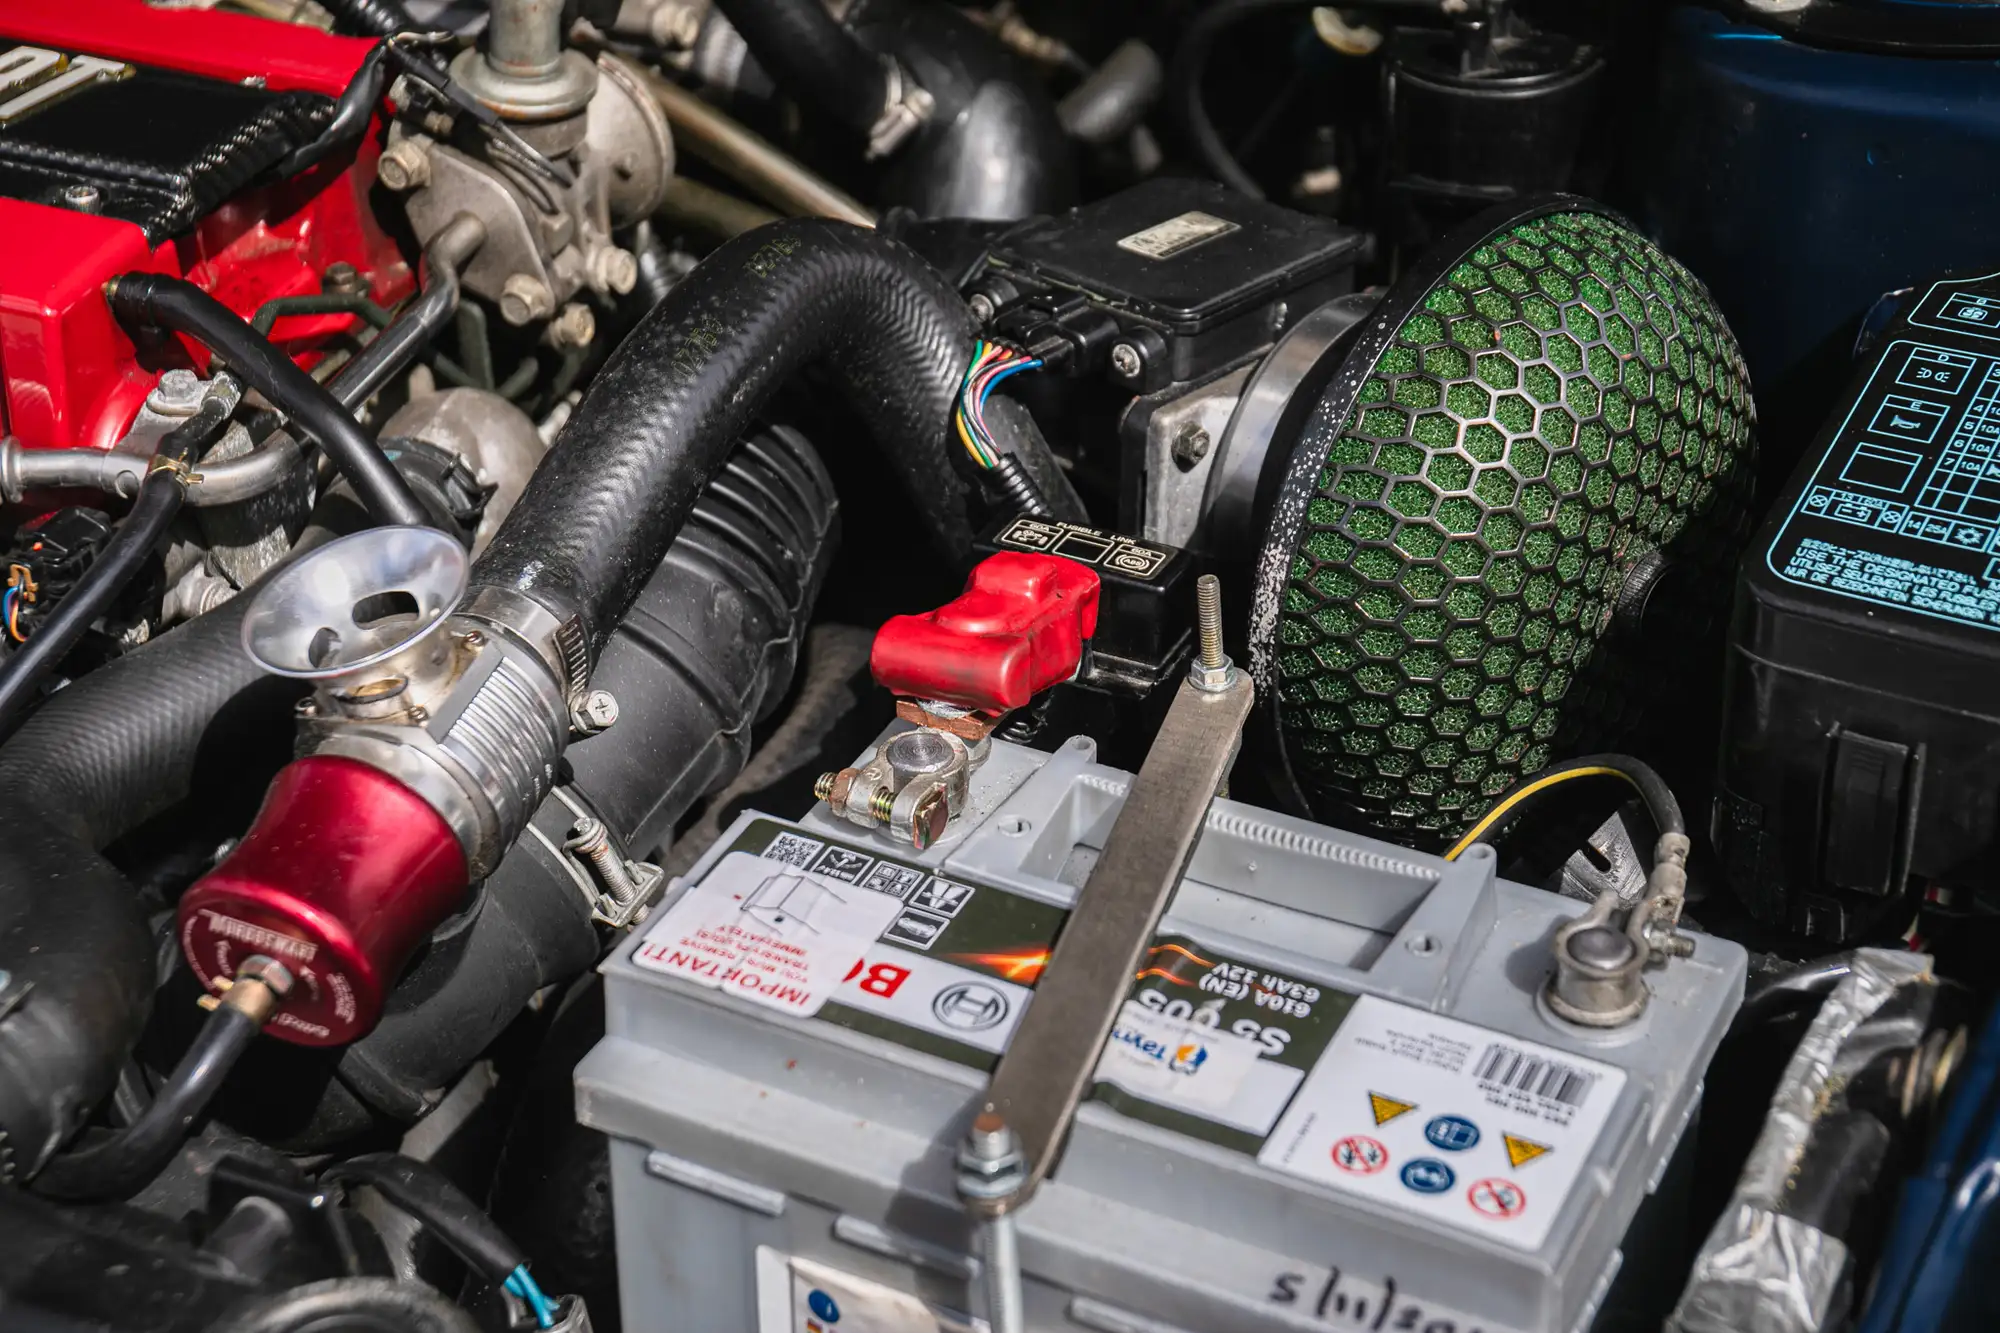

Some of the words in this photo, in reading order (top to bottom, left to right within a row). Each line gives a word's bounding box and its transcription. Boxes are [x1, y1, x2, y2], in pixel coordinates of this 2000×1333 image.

[1937, 353, 1950, 362] D
[1910, 402, 1923, 410] E
[1973, 404, 1984, 413] 4
[1963, 421, 1975, 430] 5
[1953, 439, 1965, 448] 6
[1970, 442, 1991, 453] 10A
[1943, 457, 1955, 466] 7
[1960, 461, 1981, 471] 10A
[1057, 522, 1102, 536] FUSIBLE
[1110, 534, 1137, 545] LINK
[1907, 518, 1921, 529] 14
[1925, 522, 1947, 535] 25A
[1124, 557, 1144, 567] ABS
[1796, 547, 1826, 562] USE
[1832, 556, 1862, 569] THE
[1864, 560, 1960, 592] DESIGNATED
[1784, 566, 1808, 579] NUR
[1790, 556, 1841, 576] UTILISEZ
[1842, 569, 1912, 592] SEULEMENT
[1914, 585, 1938, 599] LES
[1939, 590, 1997, 611] FUSIBLES
[643, 944, 811, 1006] IMPORTANT!
[1211, 962, 1258, 984] 12V
[1198, 973, 1249, 1000] (EN)
[1262, 974, 1320, 1003] 63Ah
[1254, 989, 1311, 1018] 610A
[1232, 1019, 1291, 1056] S5
